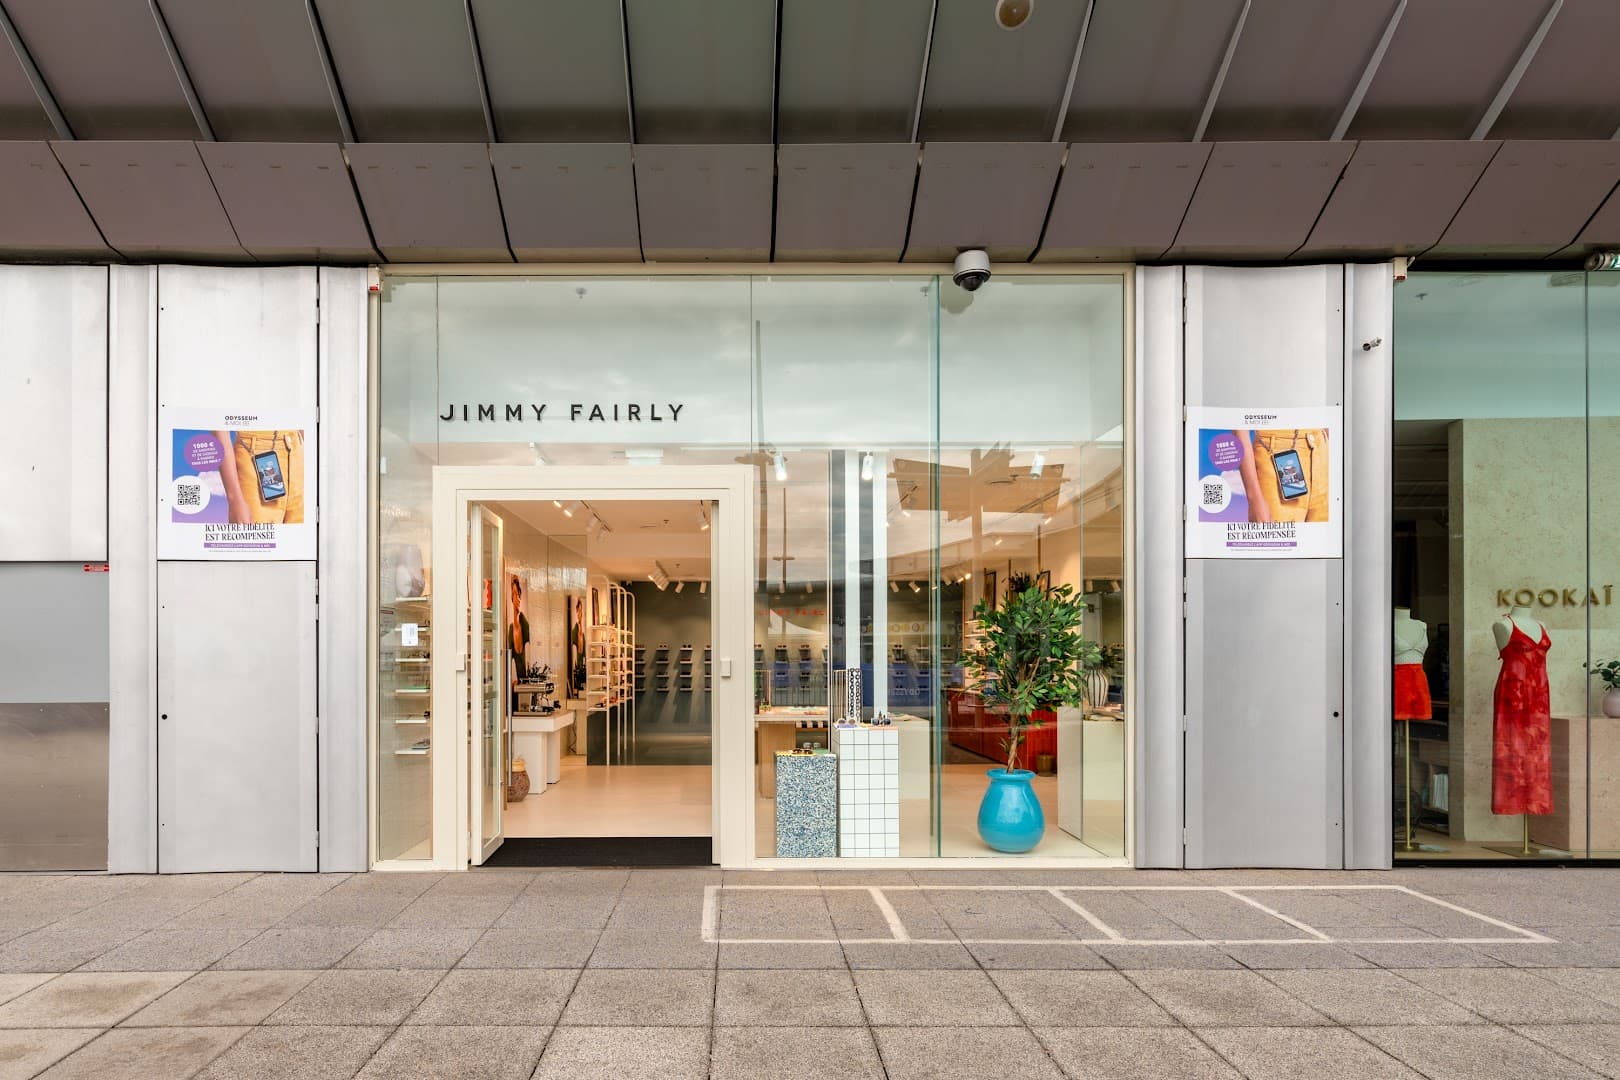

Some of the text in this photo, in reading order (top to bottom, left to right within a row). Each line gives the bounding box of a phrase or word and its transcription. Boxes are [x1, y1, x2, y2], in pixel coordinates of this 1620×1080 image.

[440, 404, 685, 421] JIMMY FAIRLY
[205, 523, 215, 532] ICI
[216, 523, 241, 532] VOTRE
[1227, 520, 1296, 531] ICI VOTRE FIDÉLITÉ
[205, 531, 275, 541] EST RÉCOMPENSÉE
[1227, 530, 1296, 540] EST RÉCOMPENSÉE
